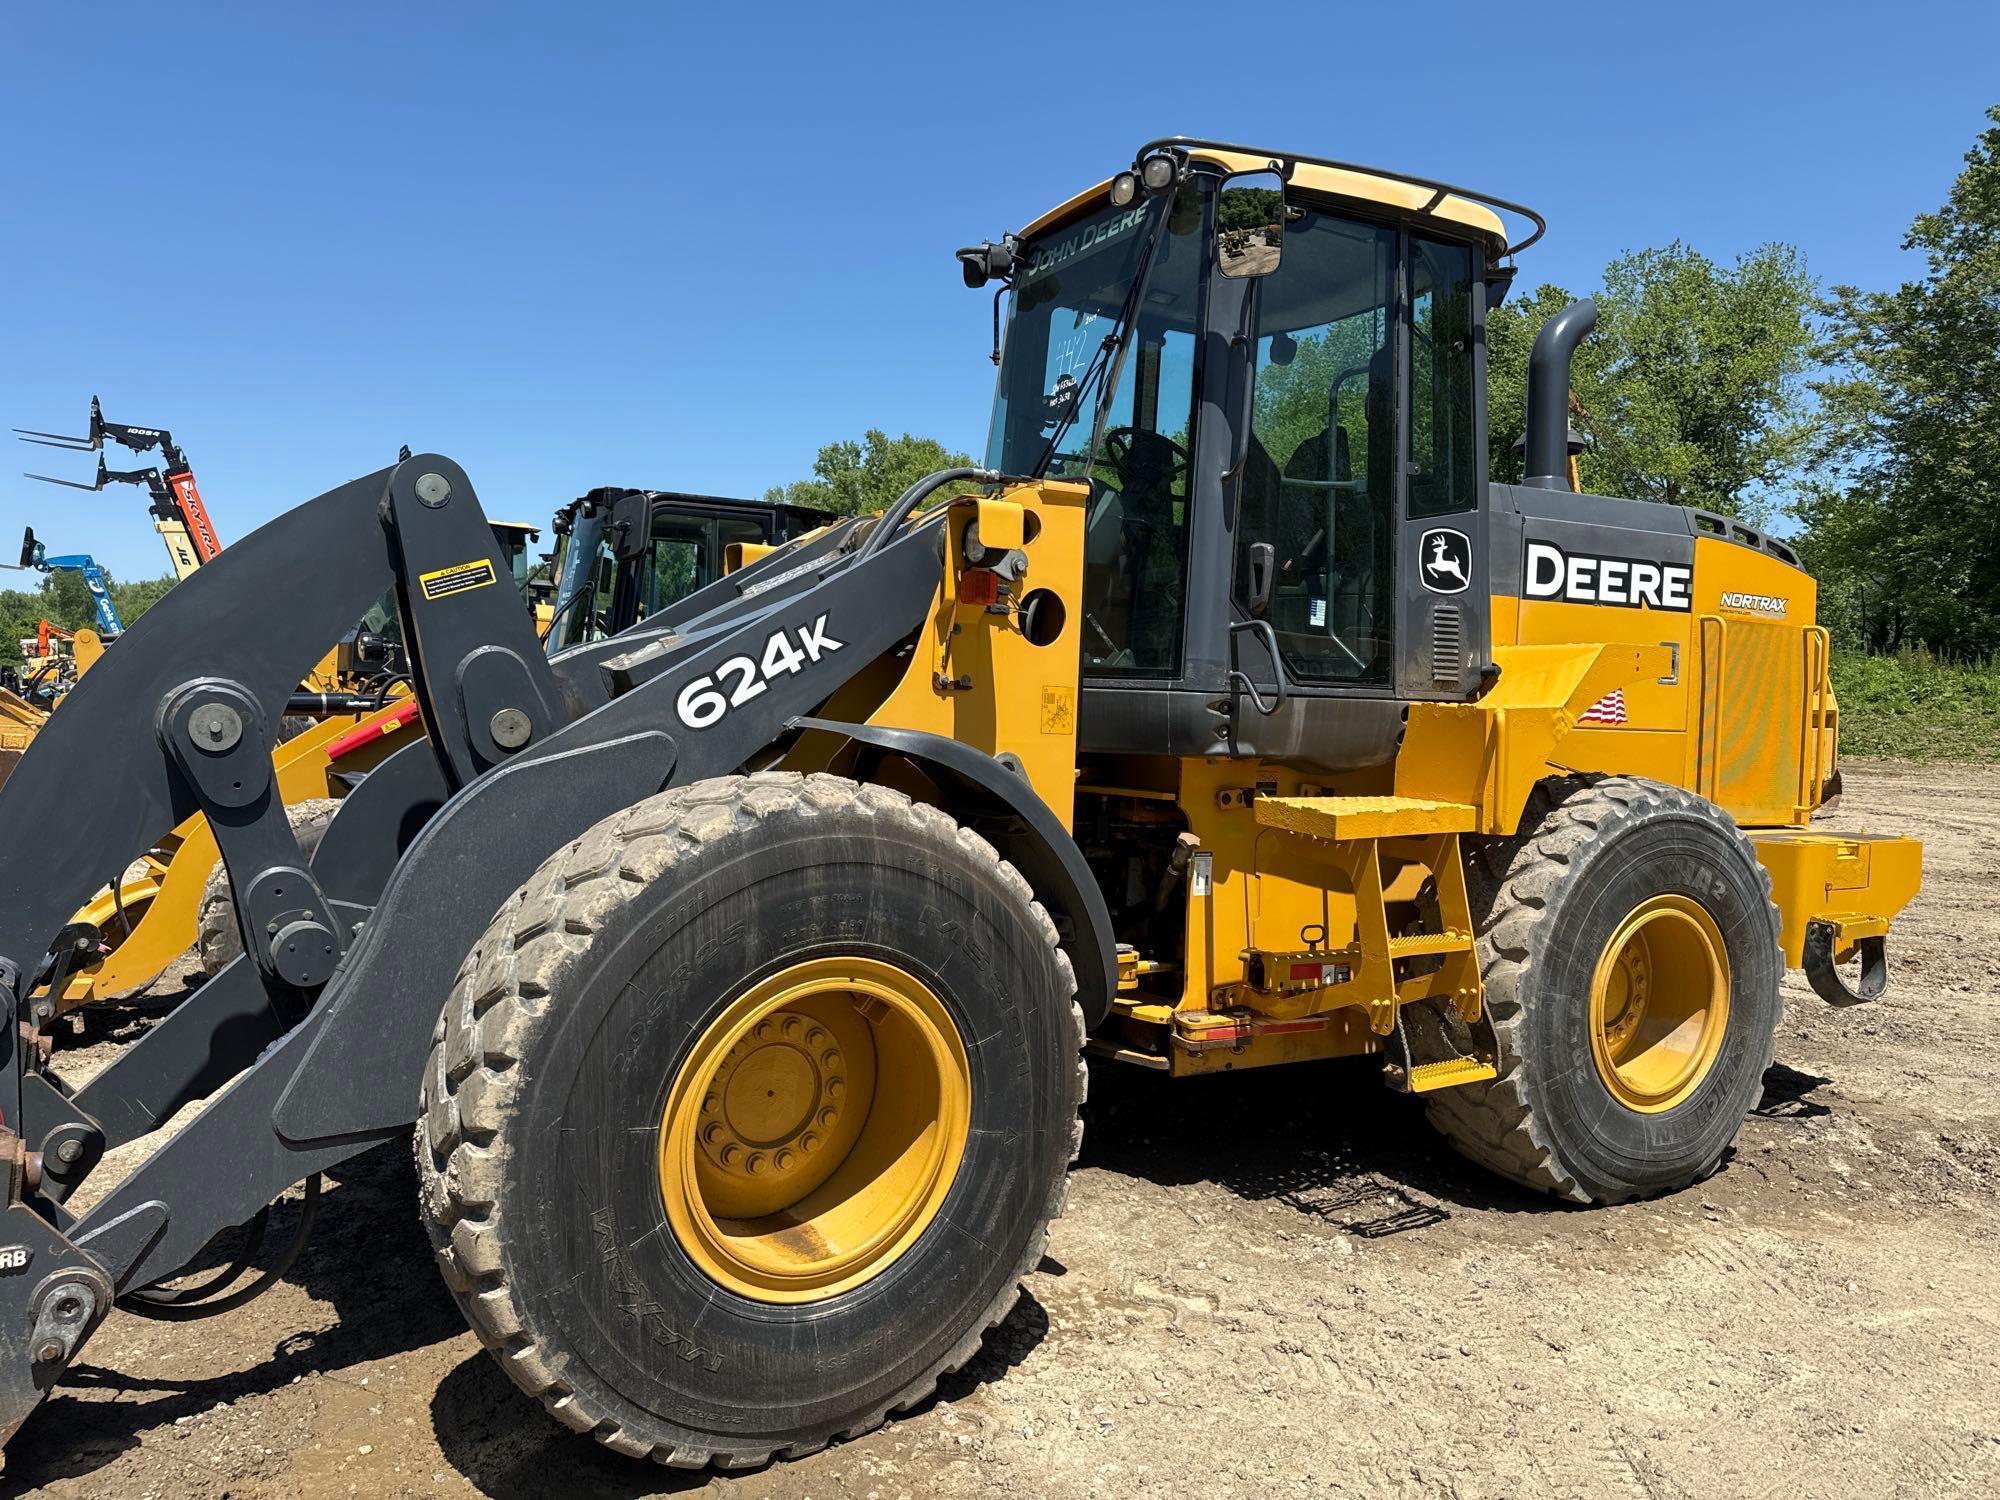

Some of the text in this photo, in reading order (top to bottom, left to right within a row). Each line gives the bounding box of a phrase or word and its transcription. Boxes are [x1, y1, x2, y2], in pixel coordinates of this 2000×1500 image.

[1028, 200, 1151, 276] JOHN DEERE
[127, 427, 161, 437] 10054
[181, 489, 216, 558] SKYTRA
[175, 546, 192, 567] JLG
[446, 564, 471, 575] CAUTION
[1526, 543, 1691, 609] DEERE
[1720, 591, 1788, 613] NORTRAX
[677, 614, 845, 729] 624K
[0, 1250, 27, 1269] RB
